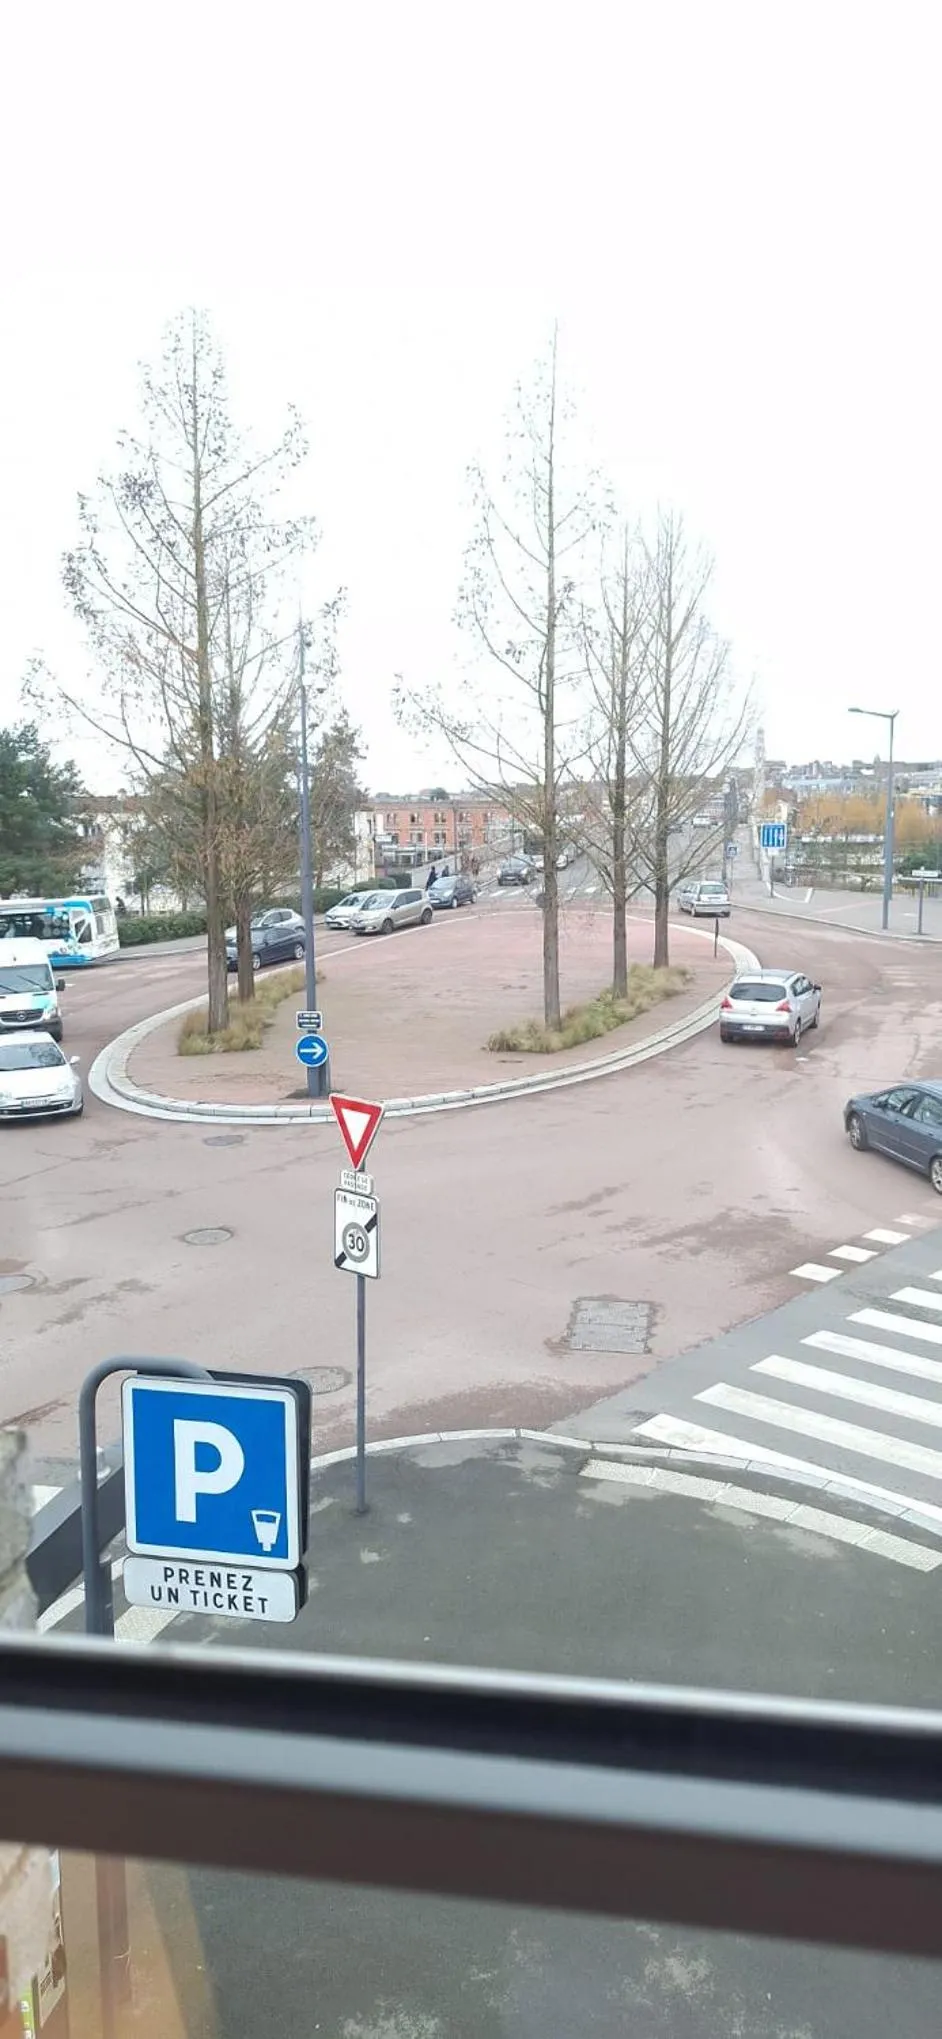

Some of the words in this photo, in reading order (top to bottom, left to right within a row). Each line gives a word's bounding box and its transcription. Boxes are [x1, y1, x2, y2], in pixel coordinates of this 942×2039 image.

[357, 1199, 374, 1211] ZONE
[349, 1233, 364, 1252] 30
[174, 1419, 245, 1523] P
[164, 1567, 253, 1591] PRENEZ
[151, 1585, 179, 1604] UN
[190, 1590, 268, 1613] TICKET
